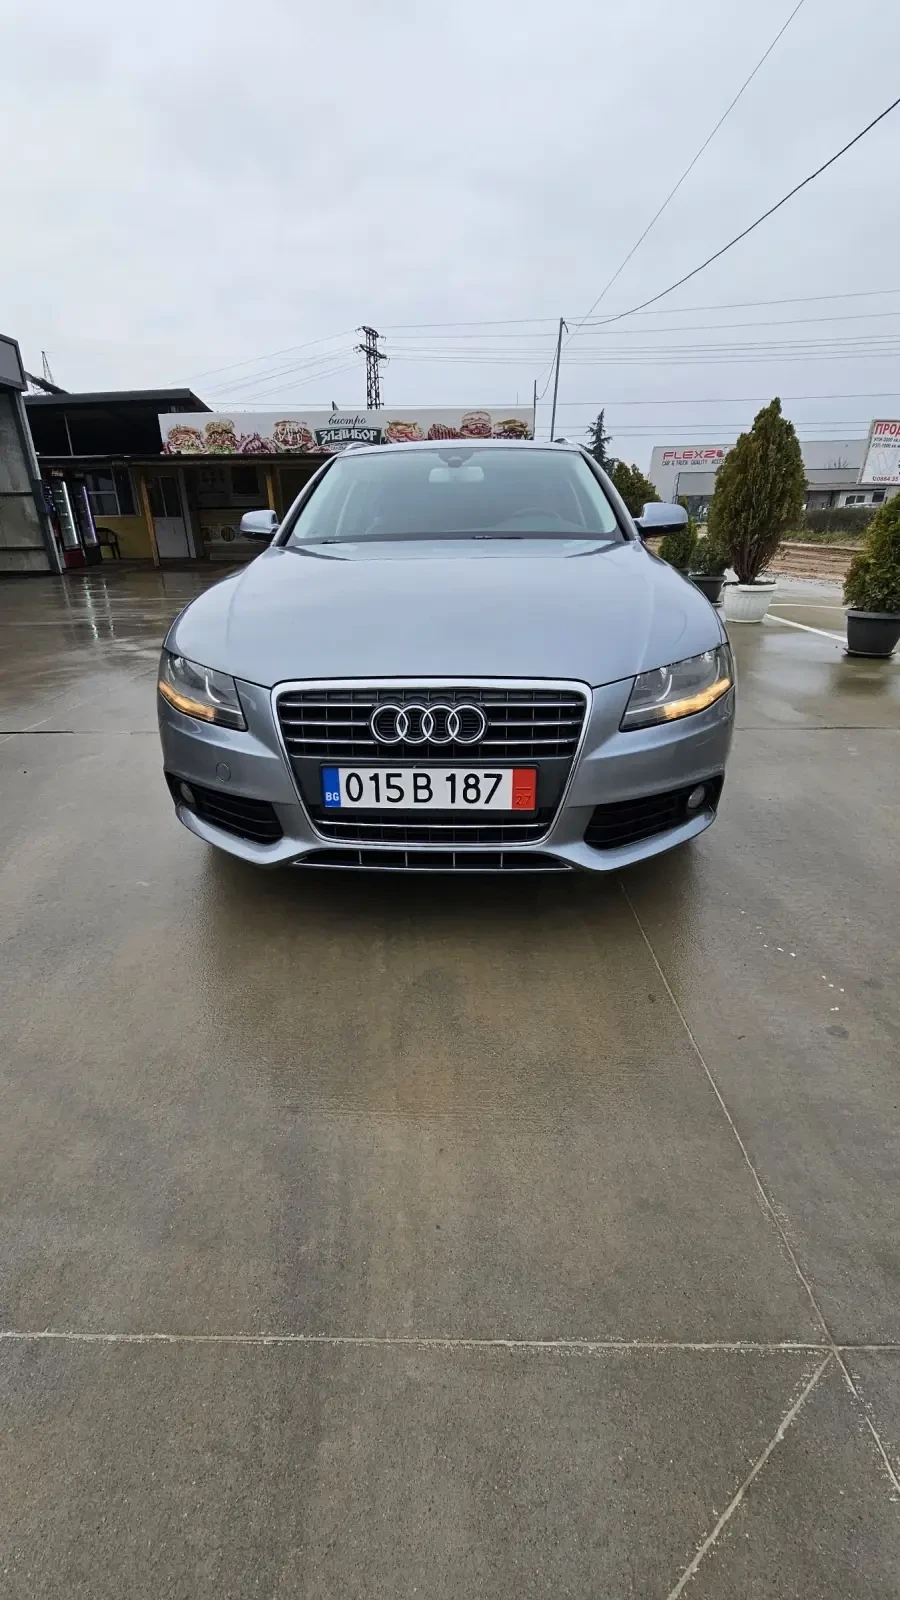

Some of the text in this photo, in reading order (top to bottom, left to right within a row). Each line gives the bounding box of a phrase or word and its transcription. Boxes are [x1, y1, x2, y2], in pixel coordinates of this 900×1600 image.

[328, 413, 367, 429] бистро
[319, 428, 378, 444] ЗЛАТИБОР
[325, 791, 340, 801] BG
[345, 772, 503, 804] 015 B 187
[515, 793, 531, 805] 27
